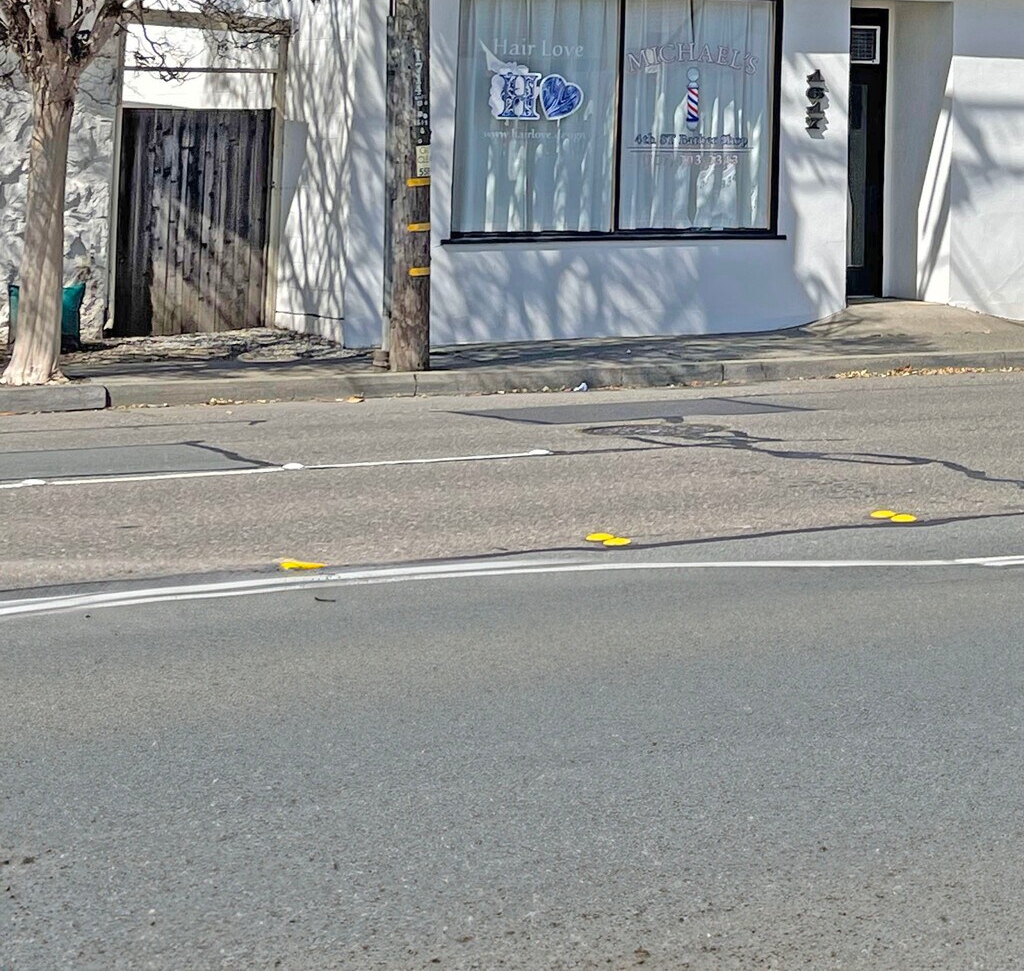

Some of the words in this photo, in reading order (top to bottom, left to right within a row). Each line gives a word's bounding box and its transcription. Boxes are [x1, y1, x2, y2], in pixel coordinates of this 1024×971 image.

[494, 37, 536, 57] Hair
[541, 39, 584, 58] Love
[626, 42, 759, 76] MICHAEL'S
[635, 132, 656, 146] 4th
